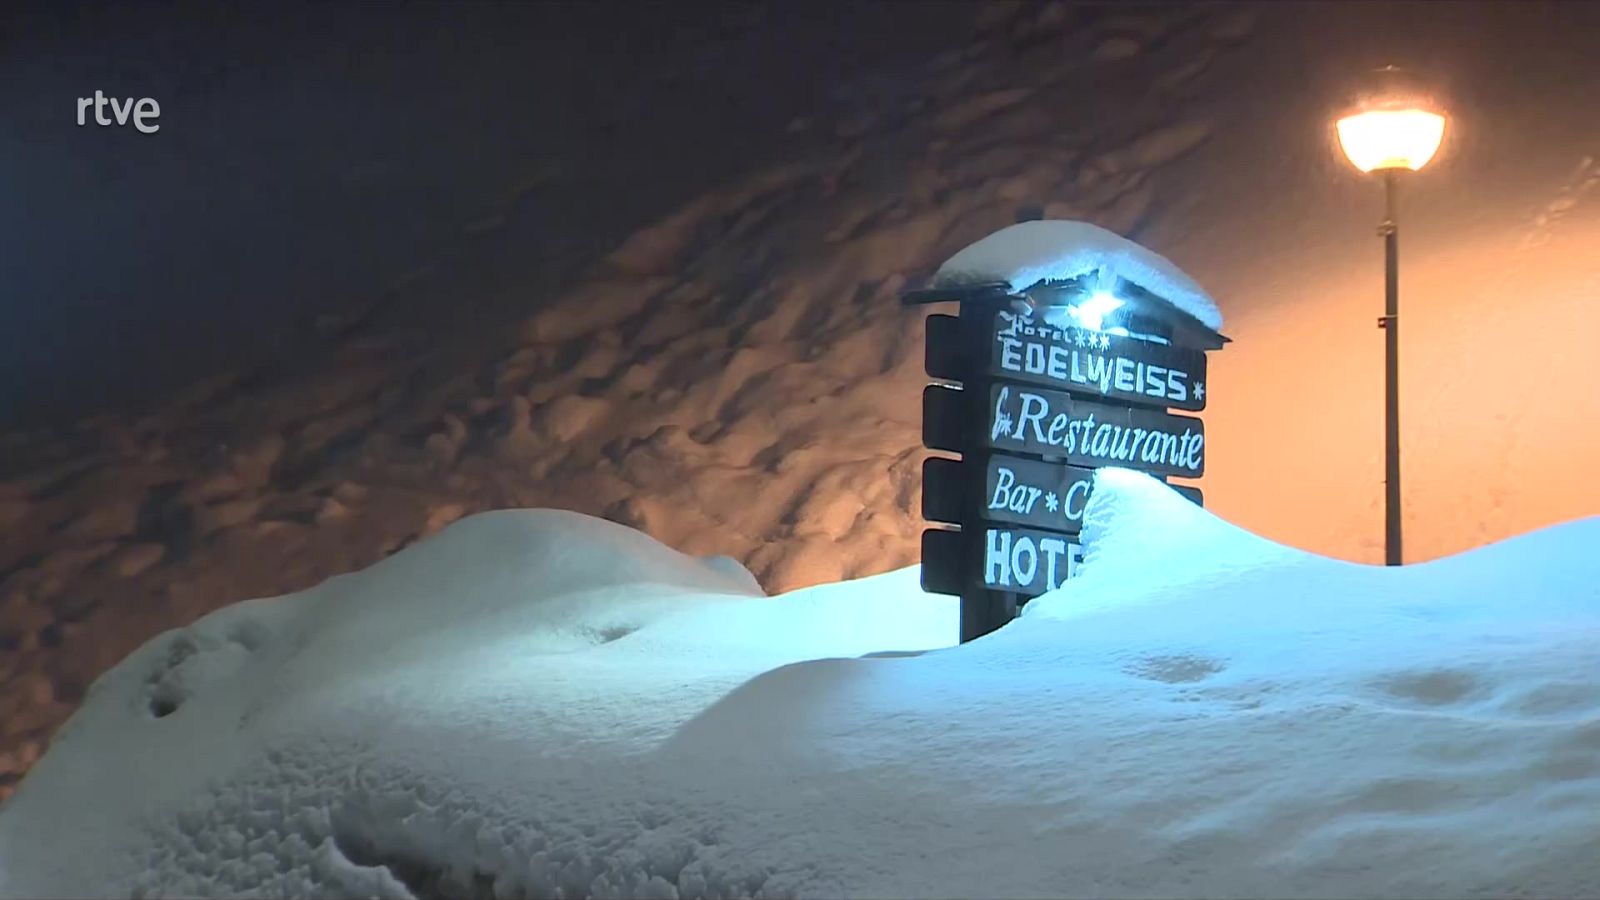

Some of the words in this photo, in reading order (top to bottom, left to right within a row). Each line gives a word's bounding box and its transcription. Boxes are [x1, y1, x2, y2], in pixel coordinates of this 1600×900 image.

[998, 311, 1073, 344] HOTEL
[998, 336, 1188, 401] EDELWEISS
[1012, 393, 1204, 470] Restaurante
[988, 468, 1042, 515] Bar
